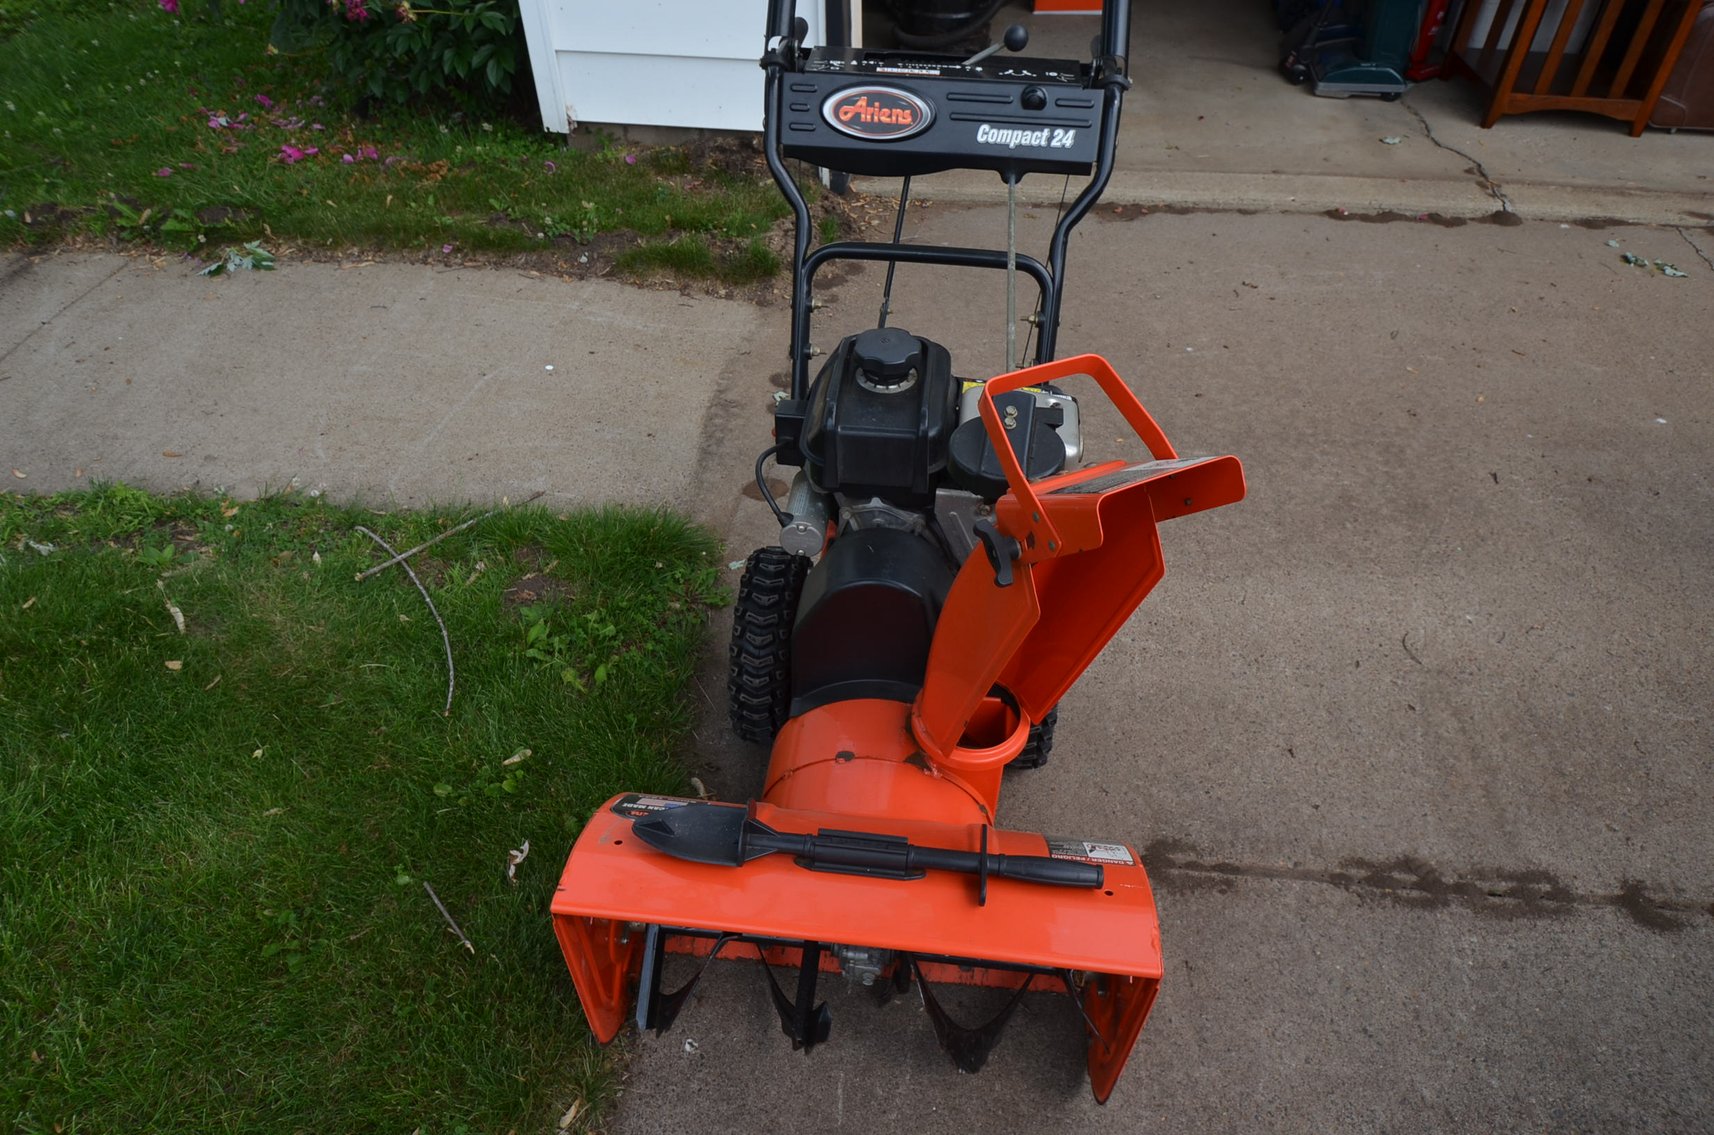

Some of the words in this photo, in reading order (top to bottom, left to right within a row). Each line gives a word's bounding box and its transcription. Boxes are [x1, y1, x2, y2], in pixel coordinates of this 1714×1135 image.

[838, 96, 913, 126] Ariens
[976, 124, 1050, 149] Compact
[1050, 129, 1075, 148] 24
